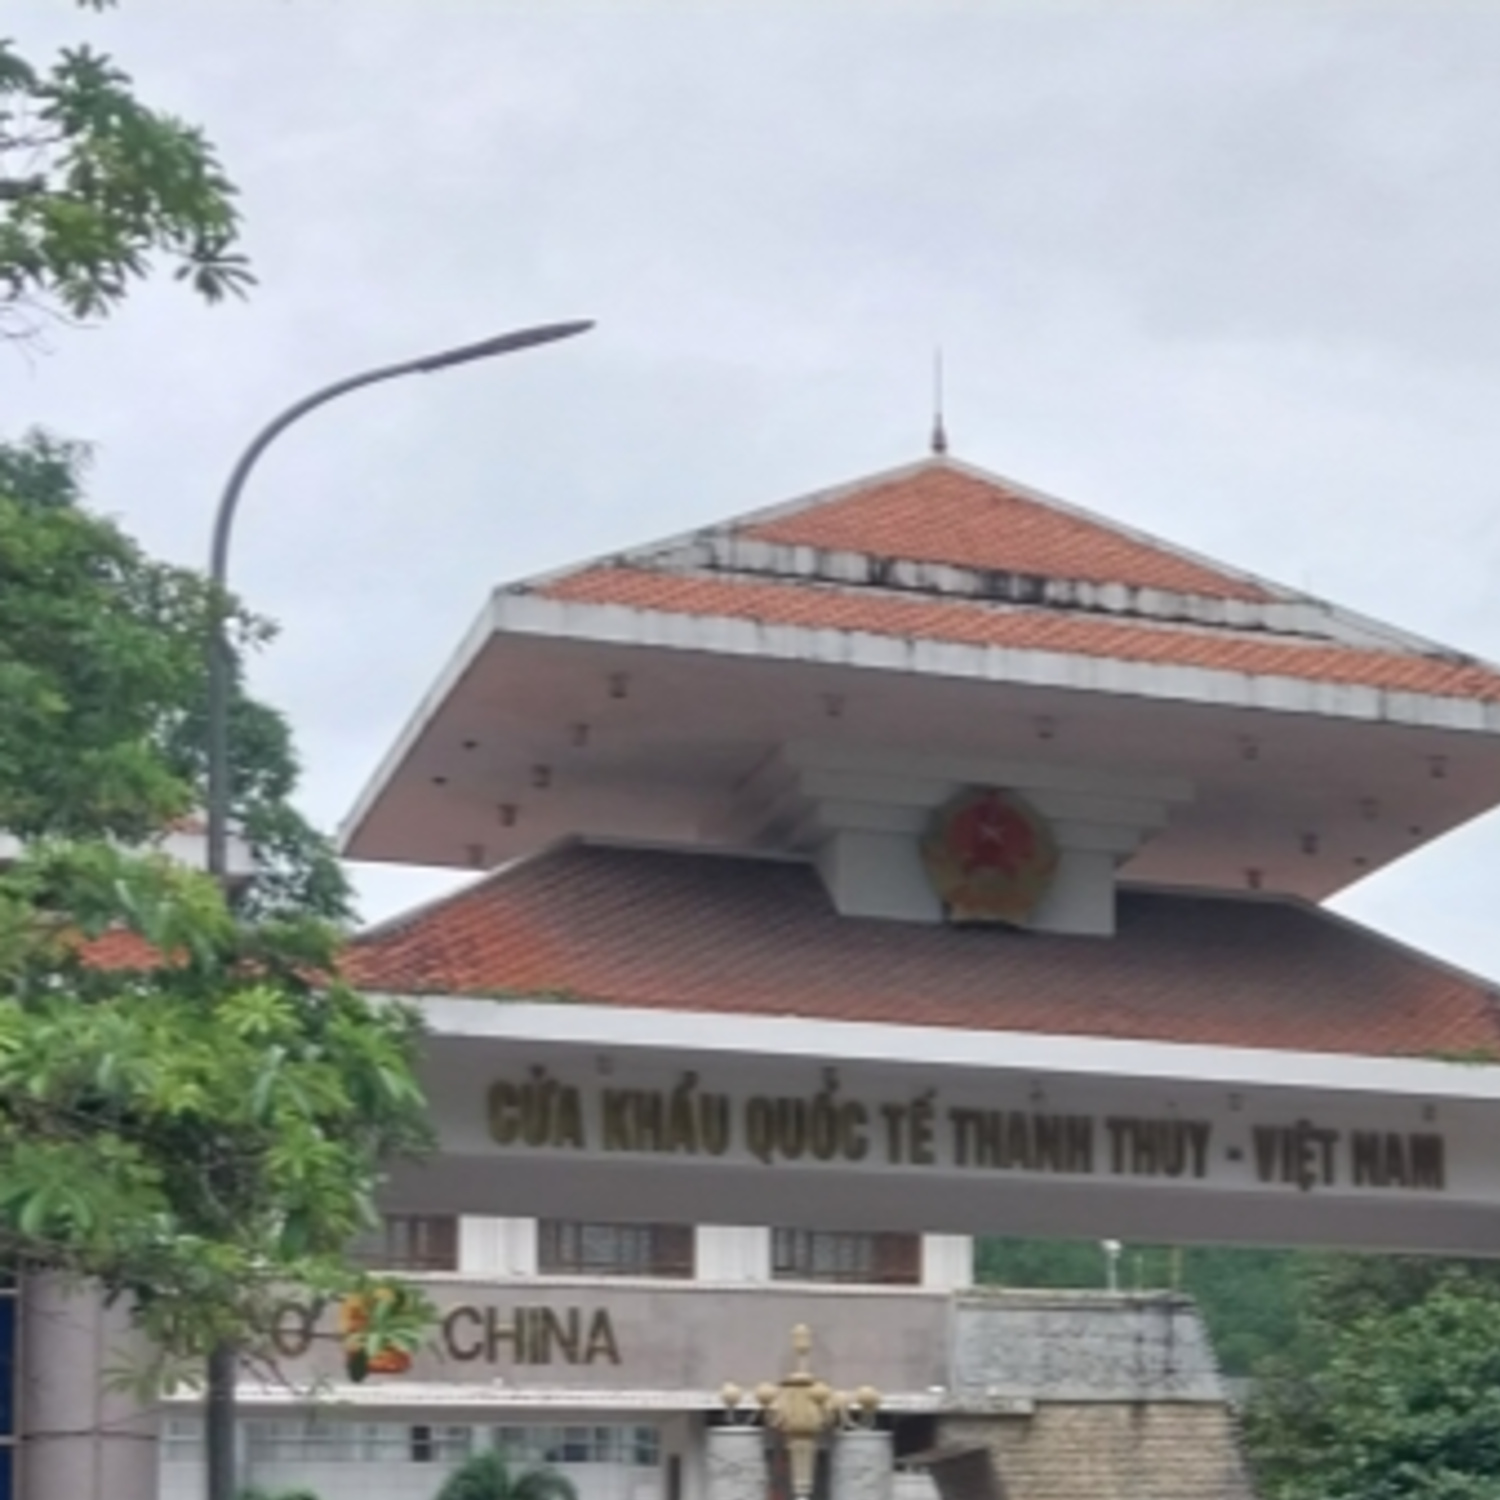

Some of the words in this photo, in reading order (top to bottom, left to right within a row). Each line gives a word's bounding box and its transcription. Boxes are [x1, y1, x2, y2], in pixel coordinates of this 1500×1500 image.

[881, 1086, 938, 1165] TẾ
[1251, 1117, 1339, 1192] VIỆT
[1350, 1129, 1445, 1190] NAM
[442, 1306, 621, 1366] CHINA
